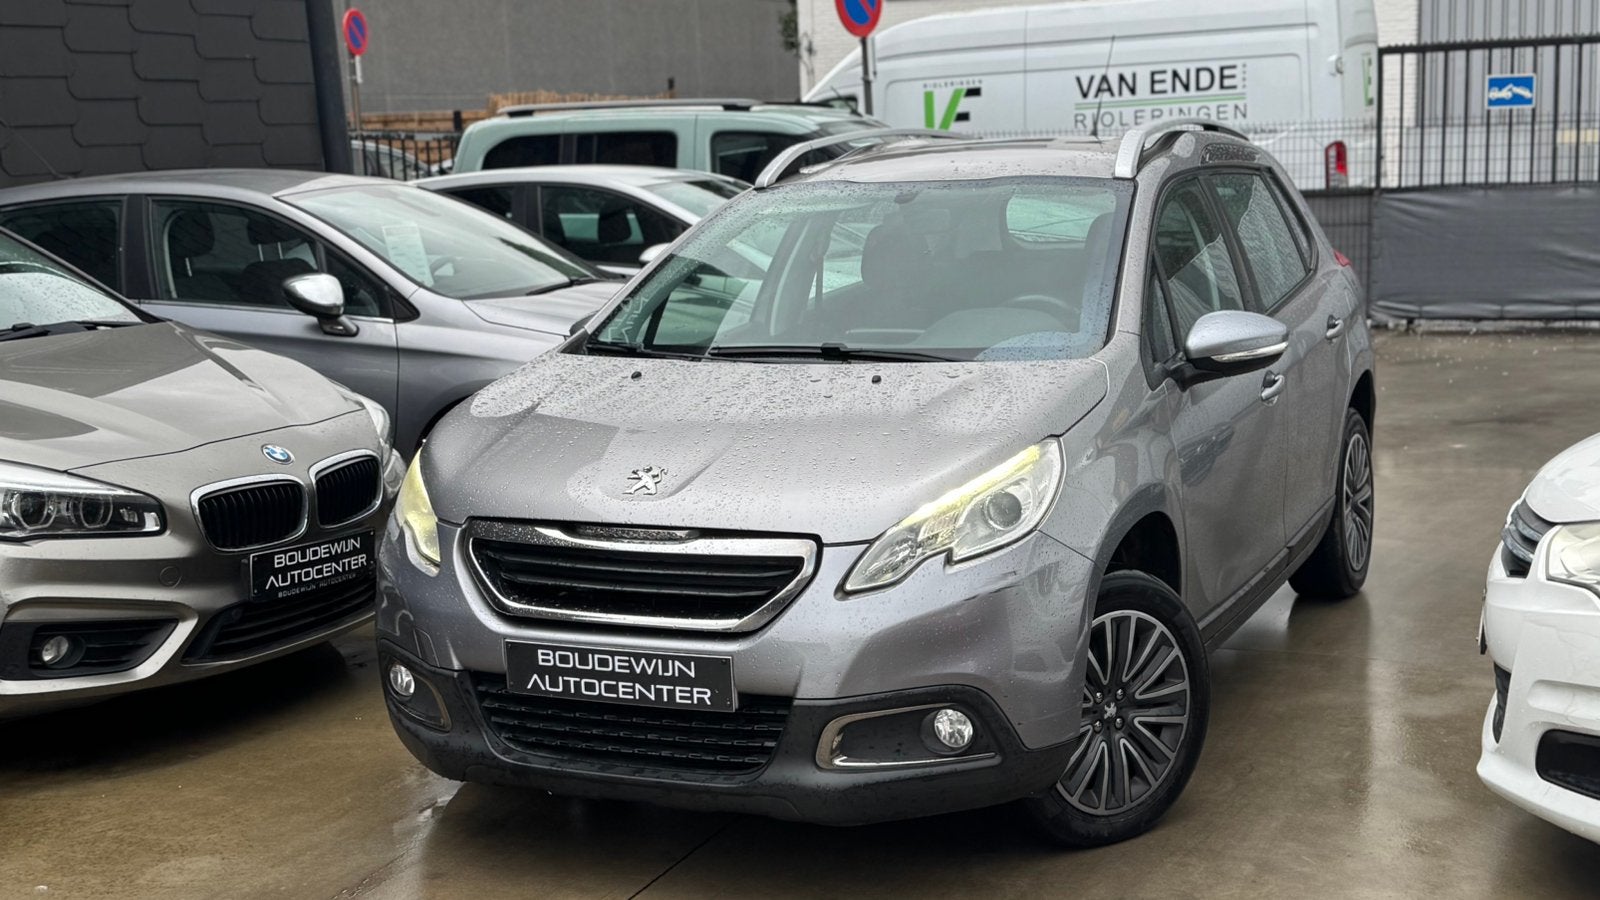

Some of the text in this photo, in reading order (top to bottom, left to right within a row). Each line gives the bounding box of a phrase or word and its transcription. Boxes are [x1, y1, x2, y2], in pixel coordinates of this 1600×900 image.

[1075, 71, 1137, 99] VAN
[1150, 65, 1238, 95] ENDE
[274, 537, 361, 568] BOUDEWIJN
[265, 553, 367, 590] AUTOCENTER
[537, 649, 696, 678] BOUDEWIJN
[526, 673, 712, 705] AUTOCENTER
